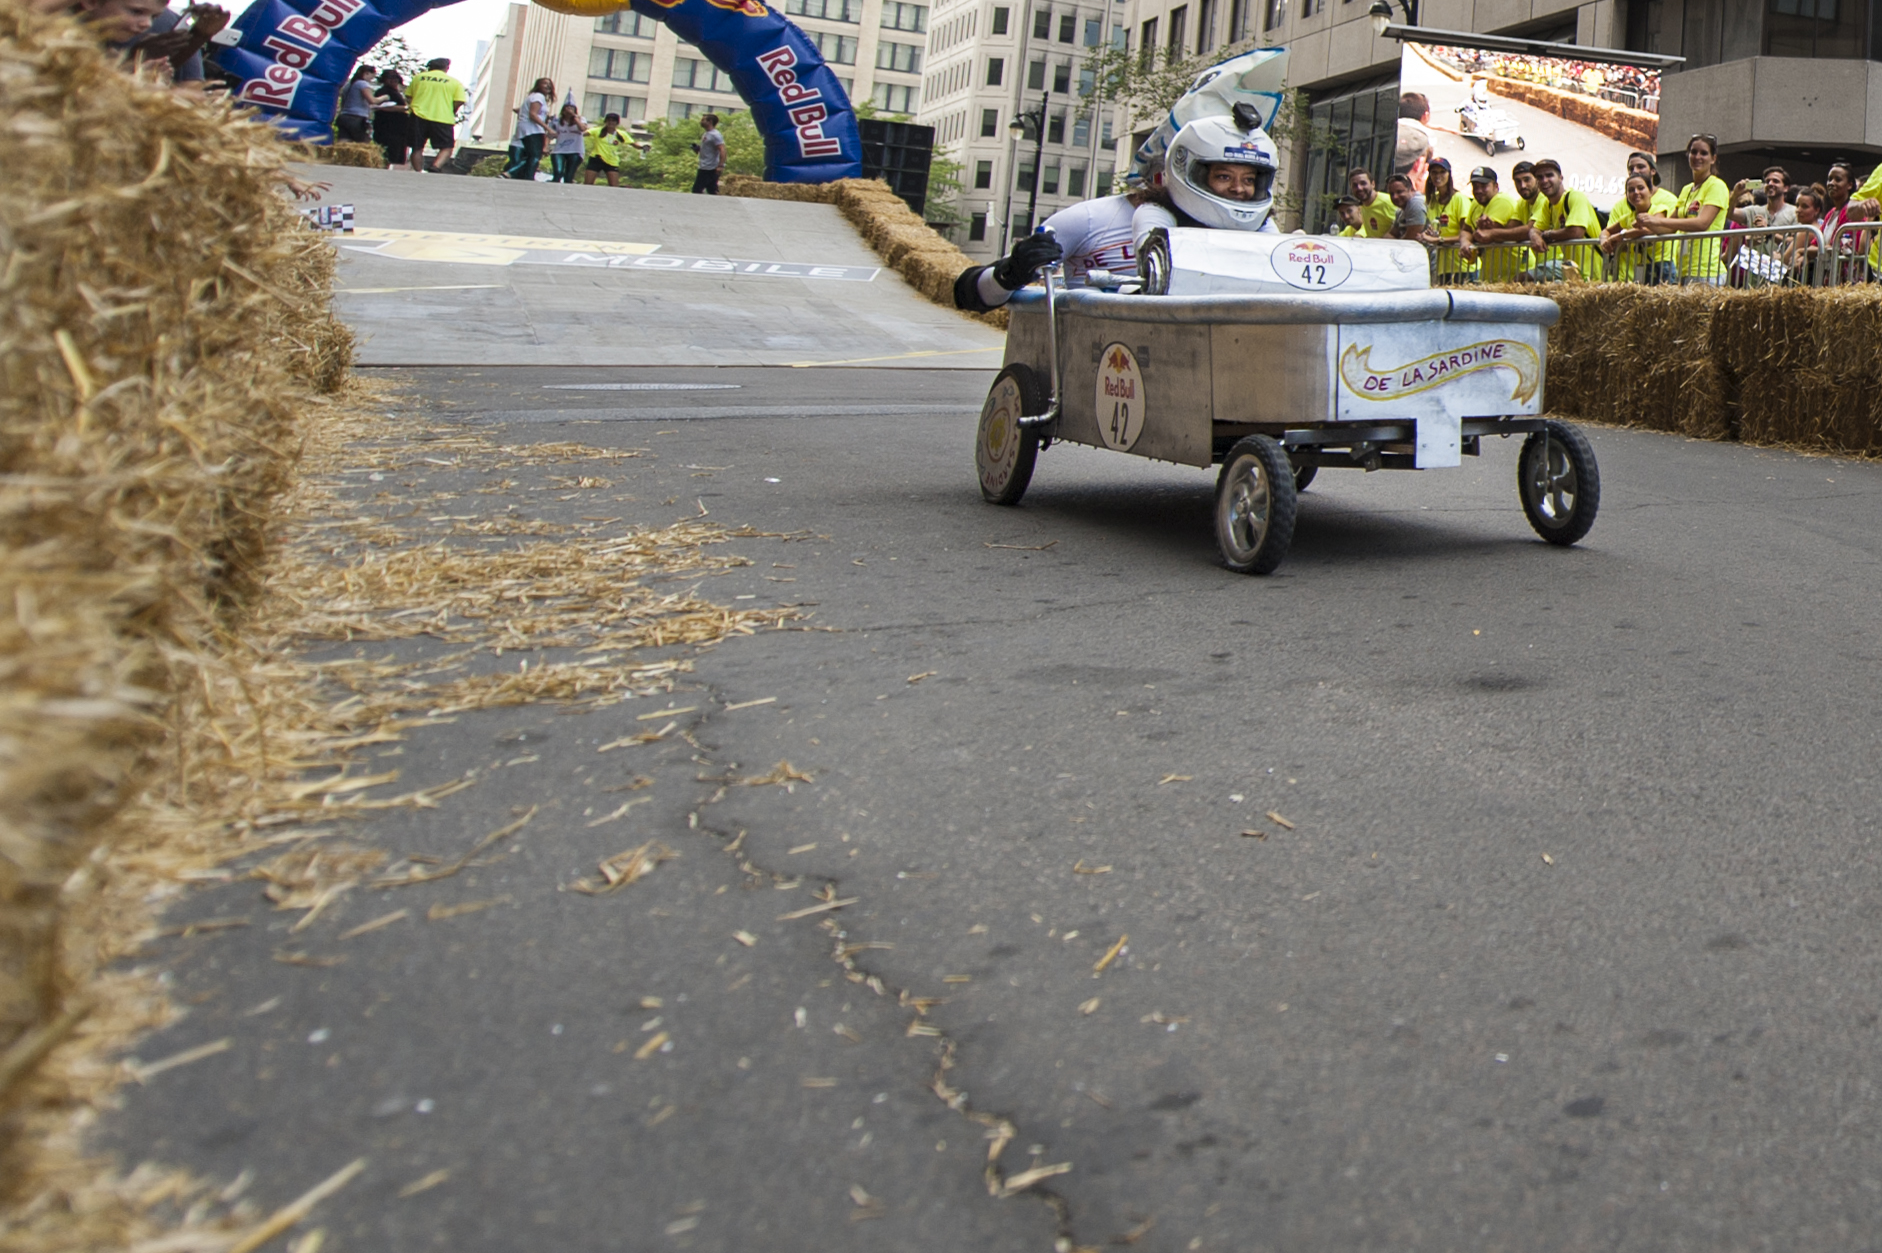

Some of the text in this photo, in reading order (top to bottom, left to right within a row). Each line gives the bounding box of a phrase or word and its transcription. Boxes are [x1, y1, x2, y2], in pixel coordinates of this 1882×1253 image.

[242, 36, 316, 108] Red
[419, 74, 450, 84] STAFF
[757, 46, 841, 157] Red Bull
[562, 252, 850, 278] MOBILE
[1083, 252, 1109, 269] DE
[1289, 252, 1334, 265] Red Bull
[1301, 264, 1327, 285] 42
[1363, 343, 1505, 391] DE LA SARDINE
[1104, 375, 1135, 400] Red Bull
[1110, 401, 1129, 446] 42
